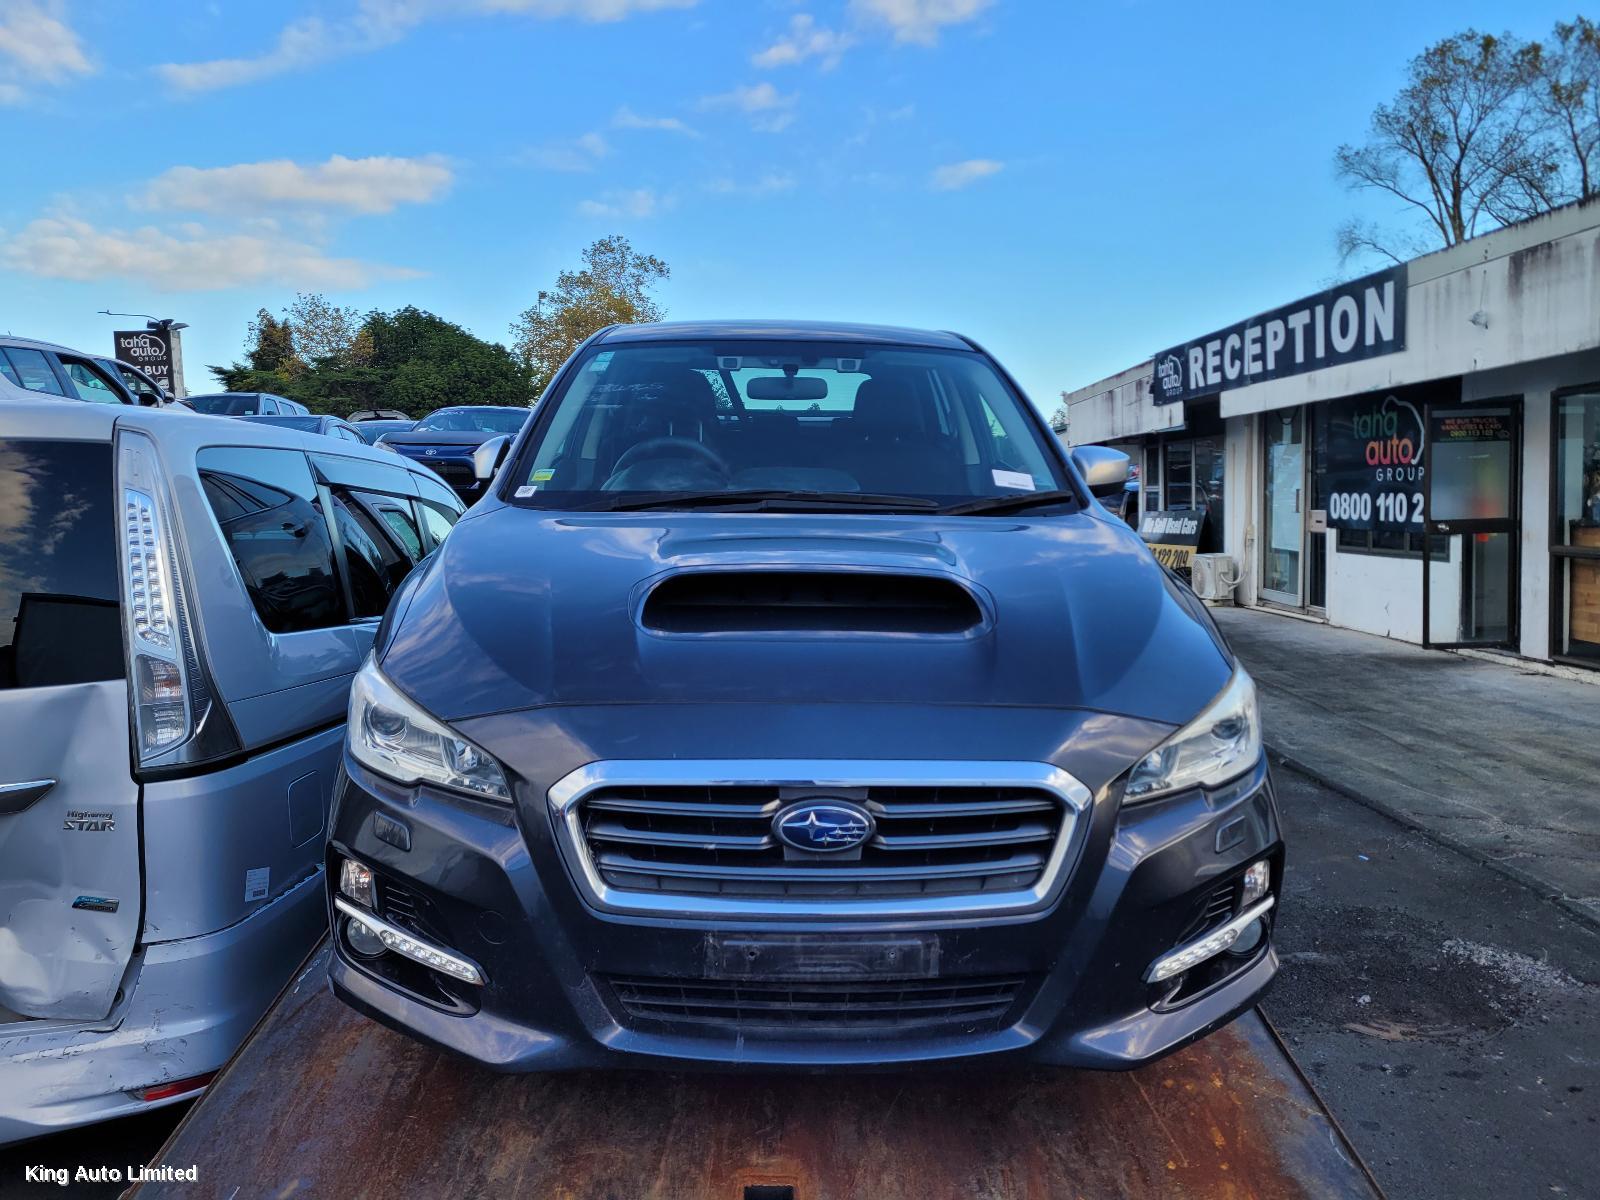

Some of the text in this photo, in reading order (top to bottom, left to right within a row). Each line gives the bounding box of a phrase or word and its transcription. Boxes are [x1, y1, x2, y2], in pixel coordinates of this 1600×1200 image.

[121, 336, 149, 348] taha
[1188, 281, 1395, 389] RECEPTION
[131, 347, 160, 357] auto
[144, 365, 169, 375] BUY
[1163, 374, 1179, 389] auto
[1353, 404, 1398, 439] taha
[1366, 433, 1413, 465] auto
[1376, 467, 1424, 481] GROUP
[1330, 492, 1371, 521] 0800
[1376, 492, 1408, 522] 110
[1152, 517, 1168, 534] Sell
[1164, 517, 1183, 534] Used
[1180, 517, 1197, 535] Cars
[66, 810, 114, 820] Highway
[63, 819, 115, 831] STAR
